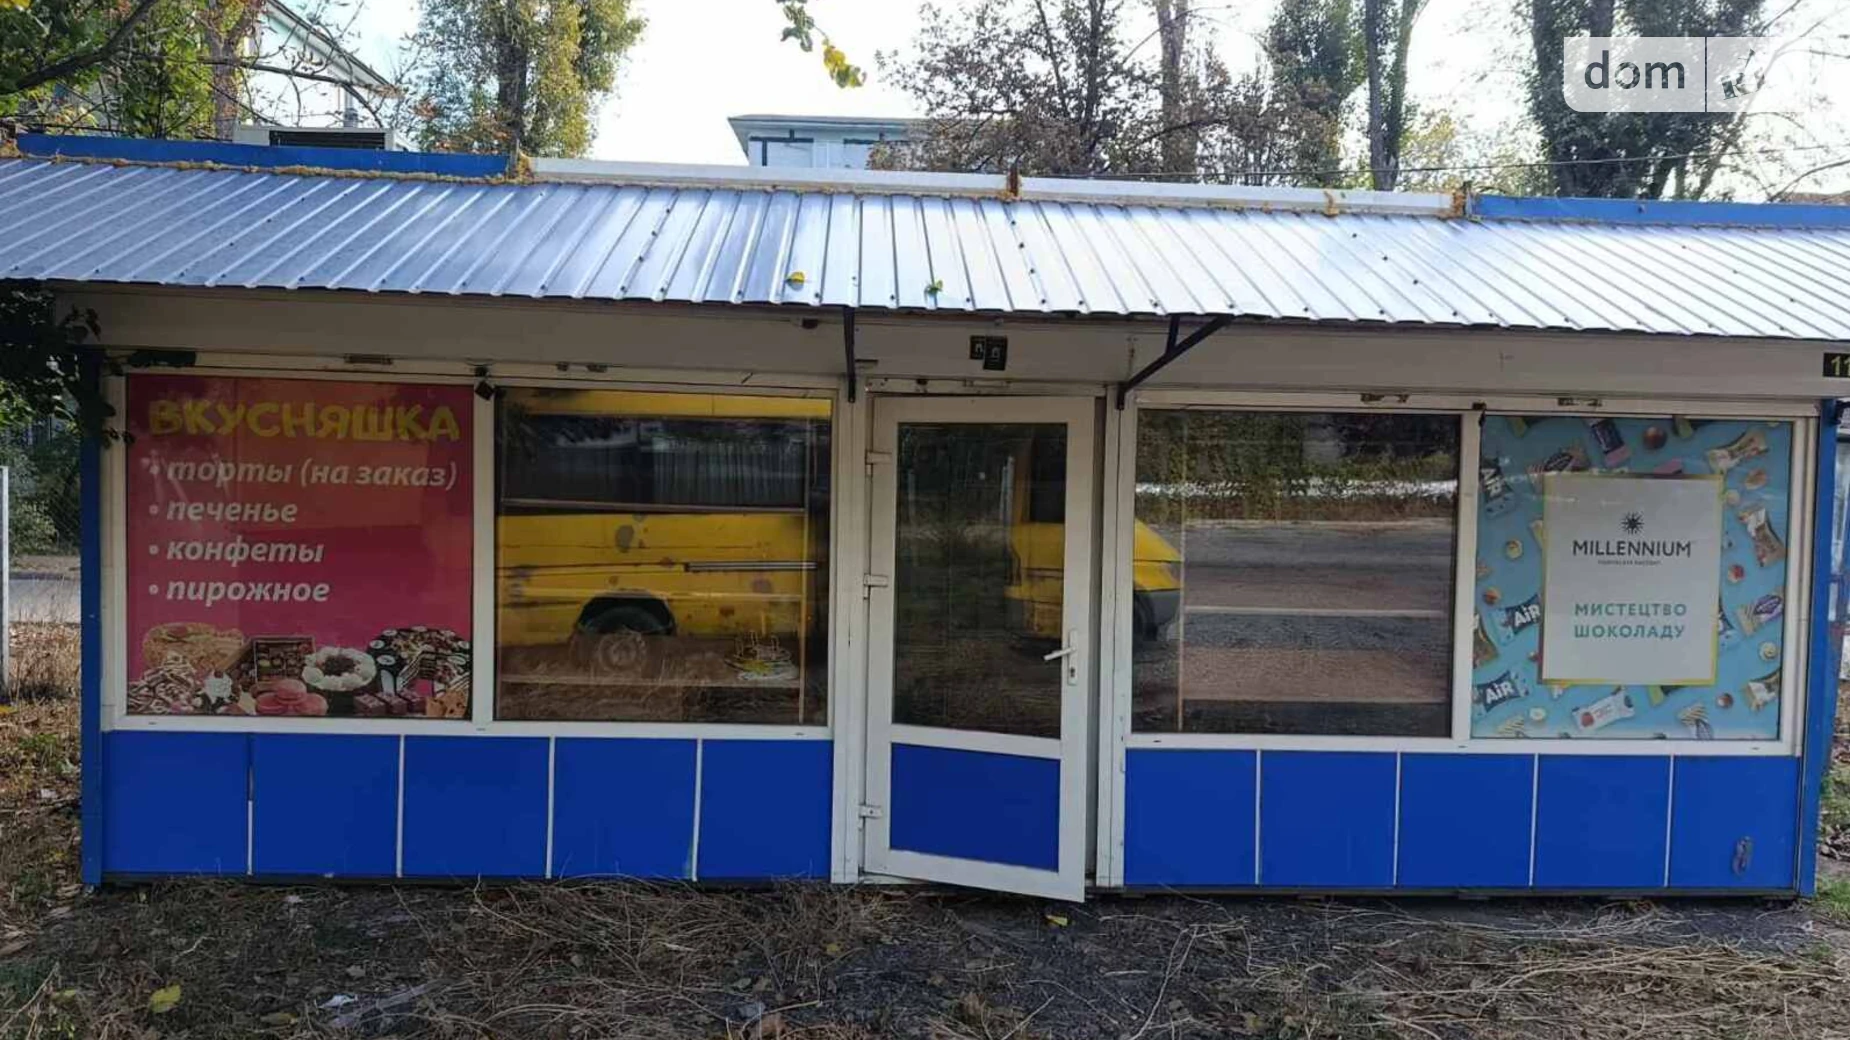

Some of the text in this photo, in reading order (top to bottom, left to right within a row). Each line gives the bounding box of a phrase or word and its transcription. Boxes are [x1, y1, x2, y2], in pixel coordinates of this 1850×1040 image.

[150, 399, 461, 441] ВКУСНЯШКА
[166, 458, 457, 490] торты (на заказ)
[167, 500, 298, 523] печенье
[167, 535, 325, 567] конфеты
[1572, 540, 1691, 558] MILLENNIUM
[167, 580, 330, 607] пирожное
[1574, 603, 1687, 617] МИСТЕЦТВО
[1574, 624, 1685, 639] ШОКОЛАДУ
